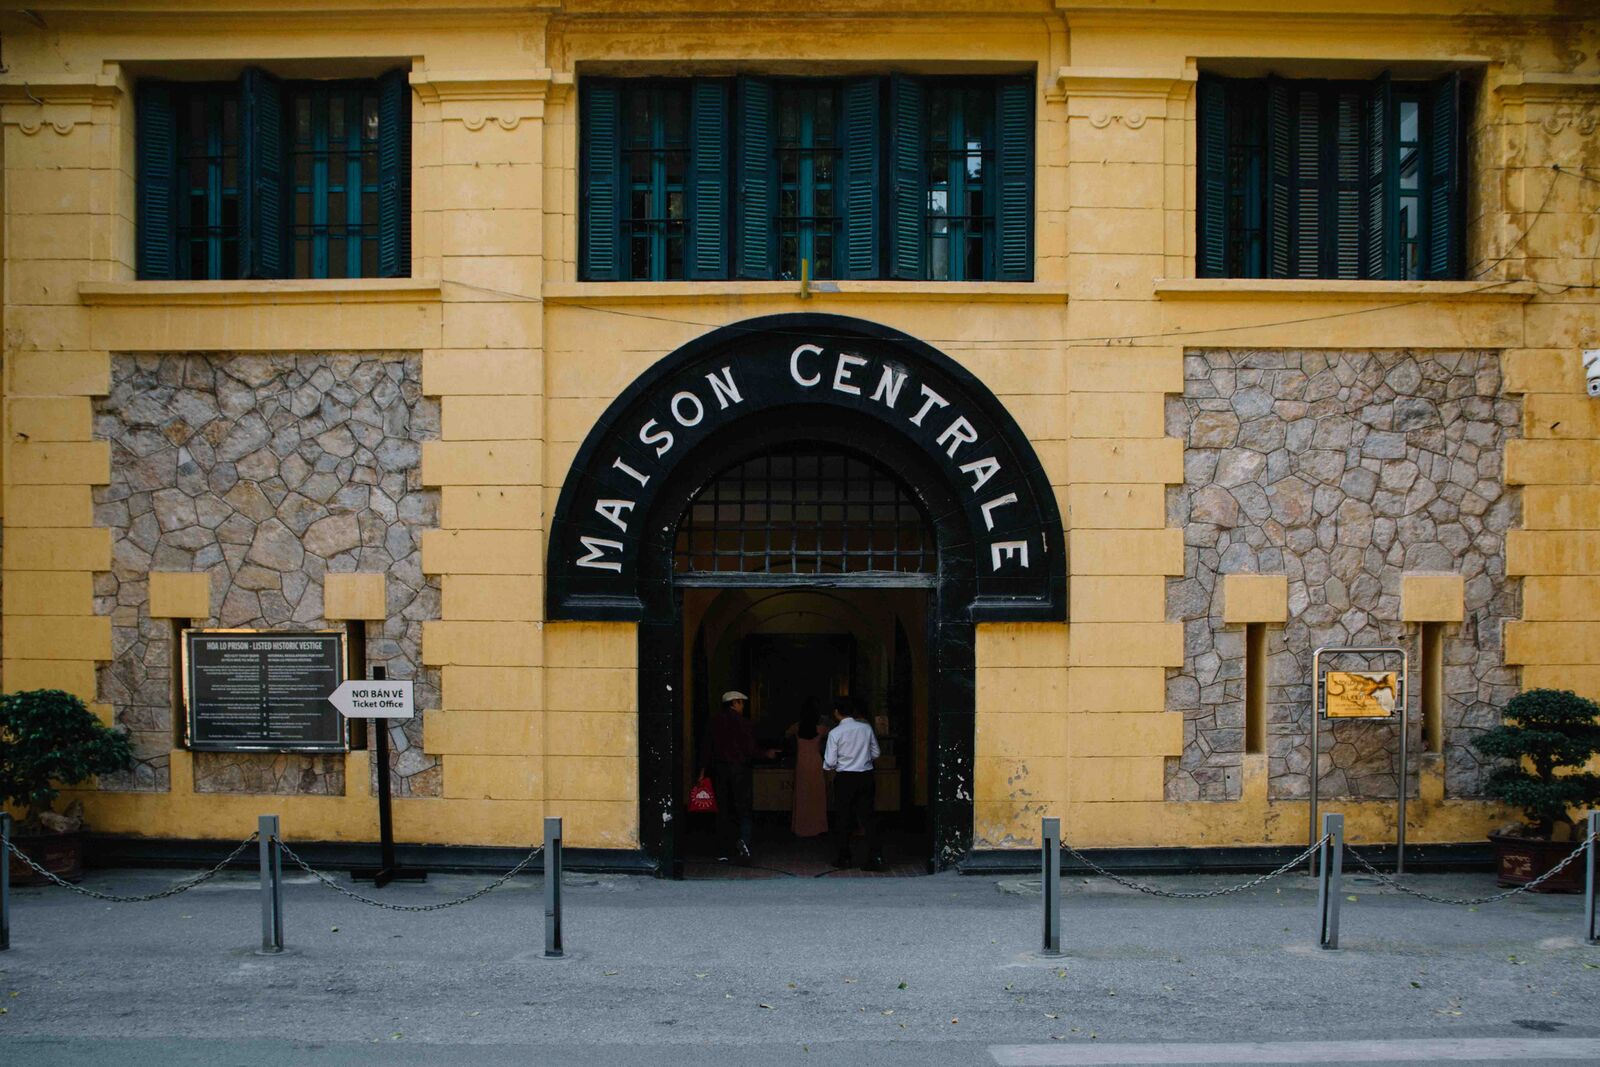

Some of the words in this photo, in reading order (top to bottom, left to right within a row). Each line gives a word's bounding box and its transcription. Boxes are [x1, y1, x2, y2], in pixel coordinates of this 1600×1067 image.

[576, 366, 744, 574] MAISON
[790, 344, 1029, 572] CENTRALE
[206, 641, 219, 650] HOA
[220, 641, 227, 650] LO
[227, 641, 249, 650] PRISON
[253, 641, 272, 650] LISTED
[272, 641, 299, 650] HISTORIC
[299, 641, 323, 650] VESTIGE
[352, 689, 369, 698] NƠI
[371, 688, 390, 698] BÁN
[352, 700, 377, 708] Ticket
[379, 700, 404, 708] Office
